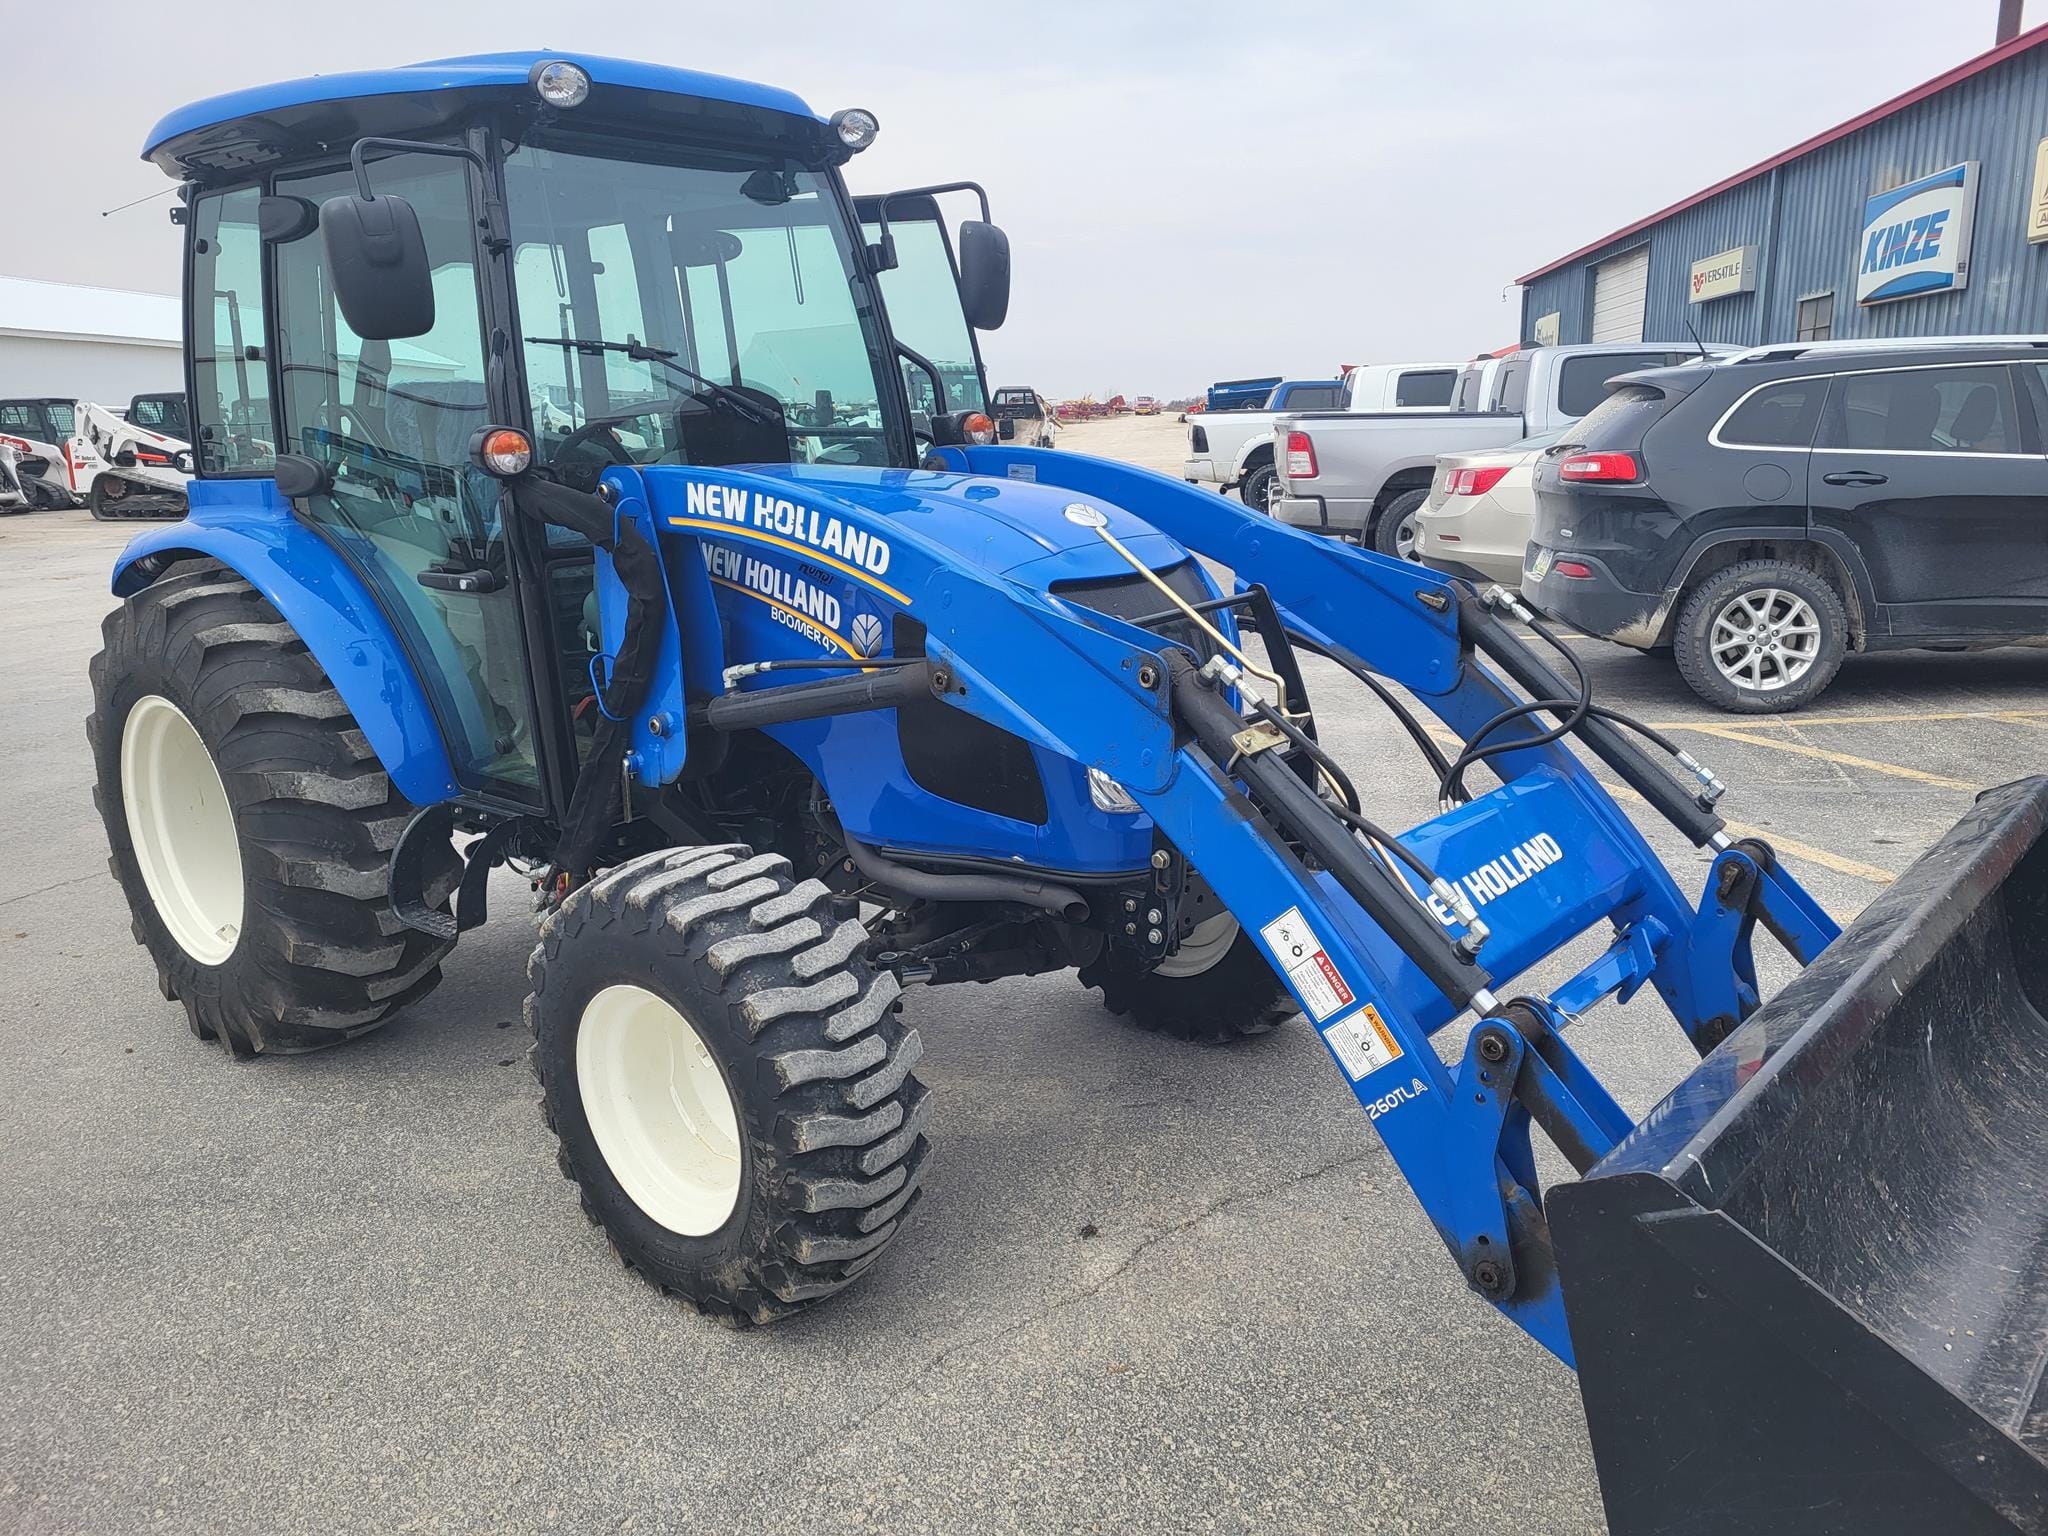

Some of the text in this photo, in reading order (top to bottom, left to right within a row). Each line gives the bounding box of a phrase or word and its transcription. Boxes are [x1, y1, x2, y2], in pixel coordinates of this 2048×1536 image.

[1862, 209, 1950, 274] KINZE
[687, 482, 890, 576] NEW HOLLAND
[702, 542, 841, 630] NEW HOLLAND
[771, 606, 839, 655] BOOMER 47
[1462, 832, 1563, 906] HOLLAND
[1323, 965, 1349, 1000] DANGER
[1373, 1020, 1395, 1052] WARNING
[1365, 1078, 1428, 1121] 260TLA
